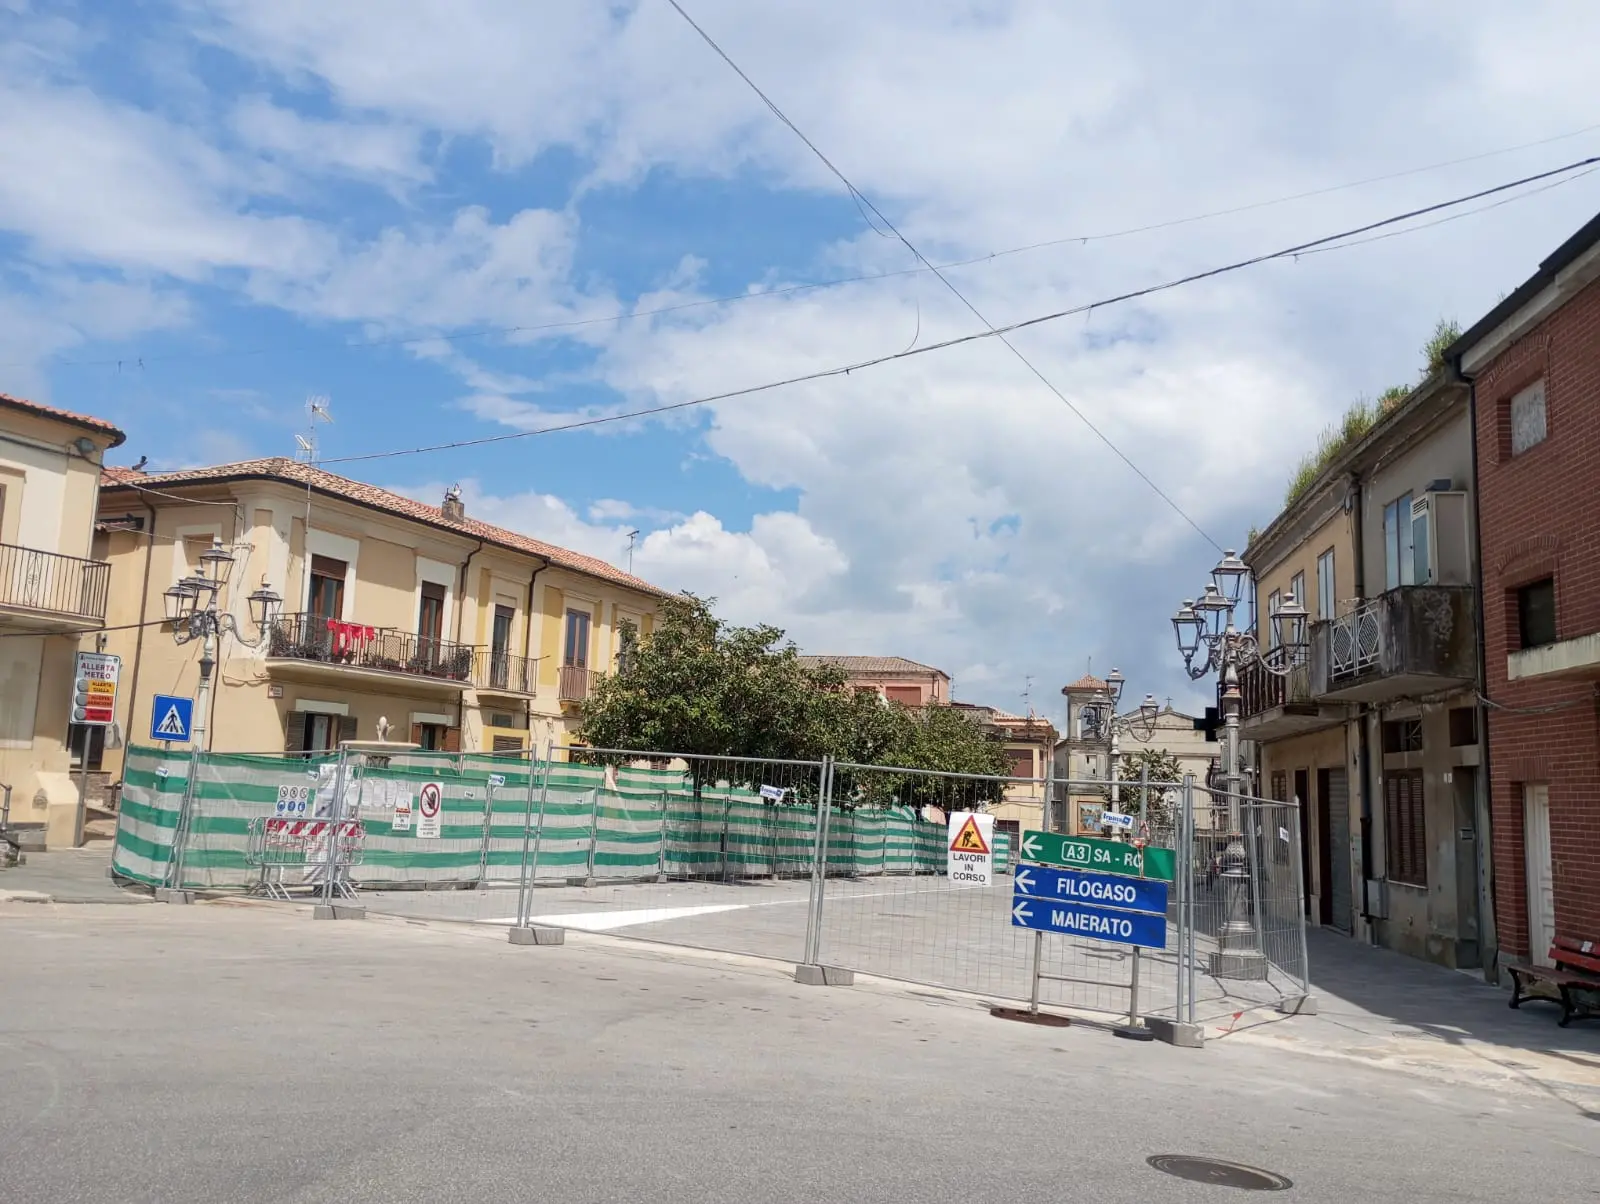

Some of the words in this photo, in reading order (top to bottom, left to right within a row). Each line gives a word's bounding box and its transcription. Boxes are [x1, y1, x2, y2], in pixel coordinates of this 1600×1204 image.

[81, 662, 115, 672] ALLERTA
[84, 671, 111, 679] METEO
[953, 853, 986, 863] LAVORI
[1066, 845, 1086, 860] A3
[1093, 848, 1111, 864] SA
[964, 863, 974, 872] IN
[953, 872, 986, 883] CORSO
[1057, 877, 1136, 903] FILOGASO
[1051, 909, 1133, 937] MAIERATO
